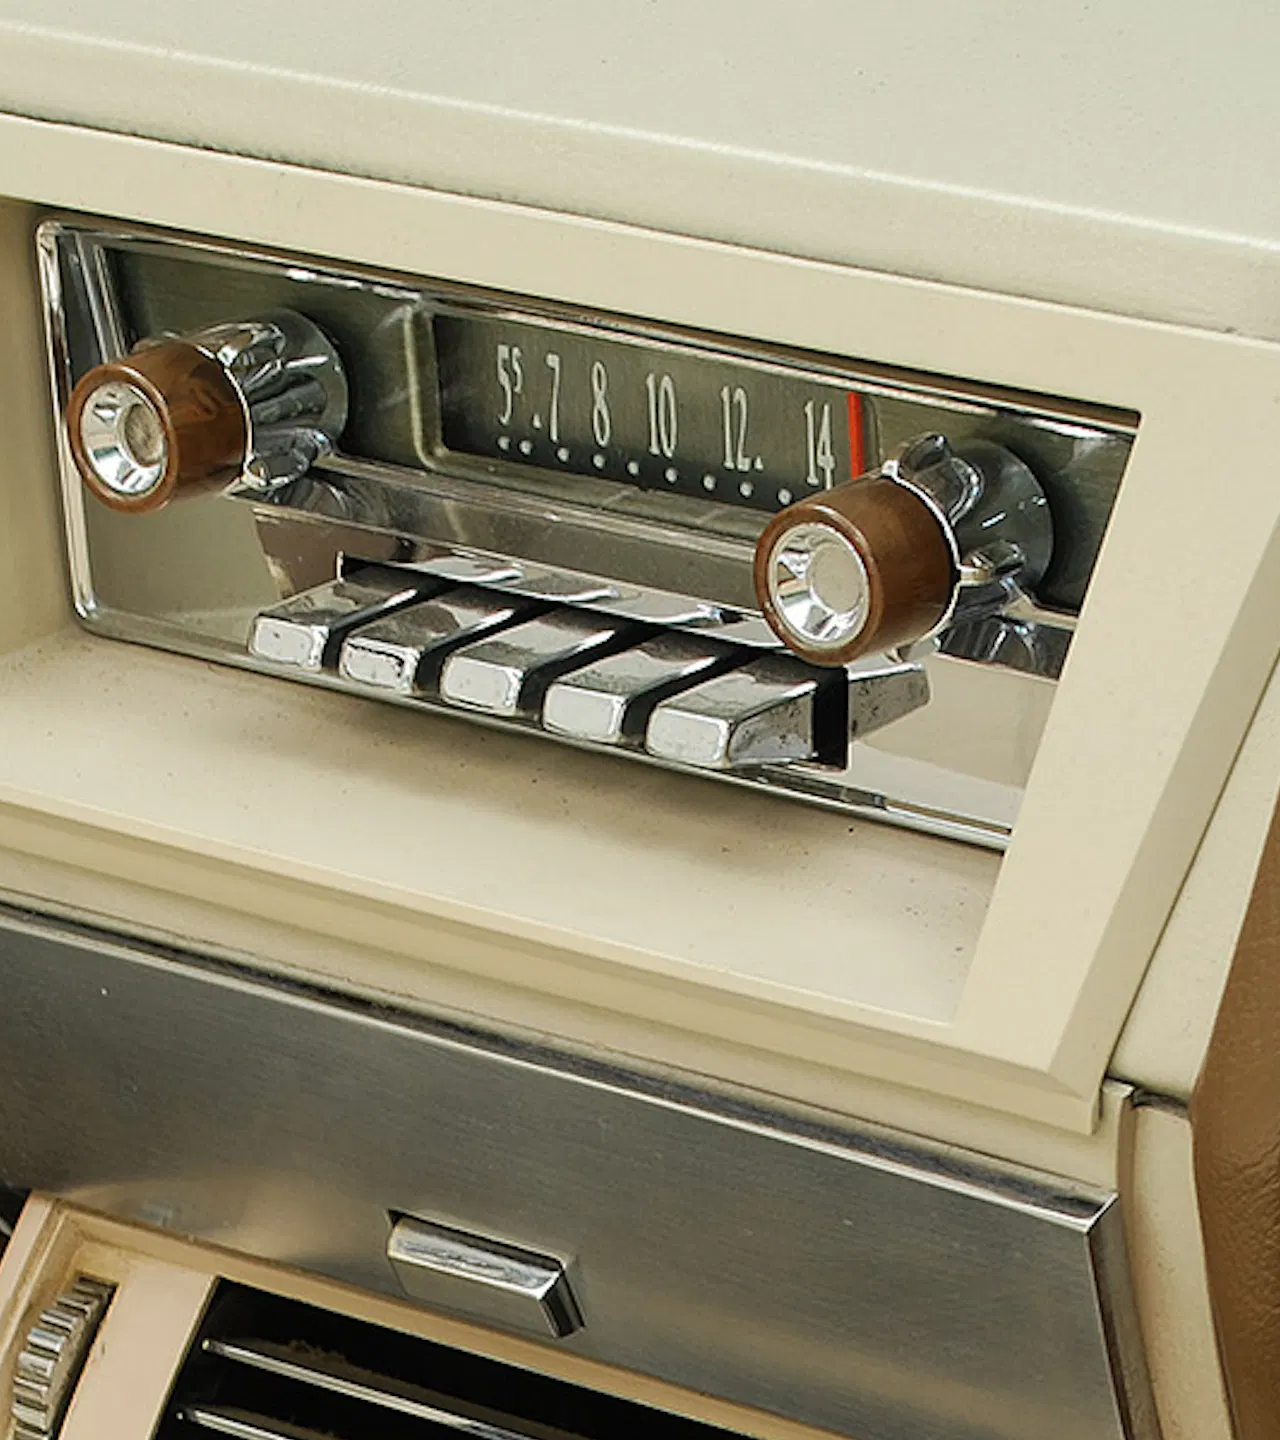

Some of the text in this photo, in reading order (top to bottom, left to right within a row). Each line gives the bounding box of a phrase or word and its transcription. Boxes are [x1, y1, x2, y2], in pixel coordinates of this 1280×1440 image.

[546, 353, 560, 443] 7
[592, 361, 610, 447] 8
[646, 373, 677, 458] 10
[721, 385, 751, 471] 12
[804, 400, 835, 491] 14
